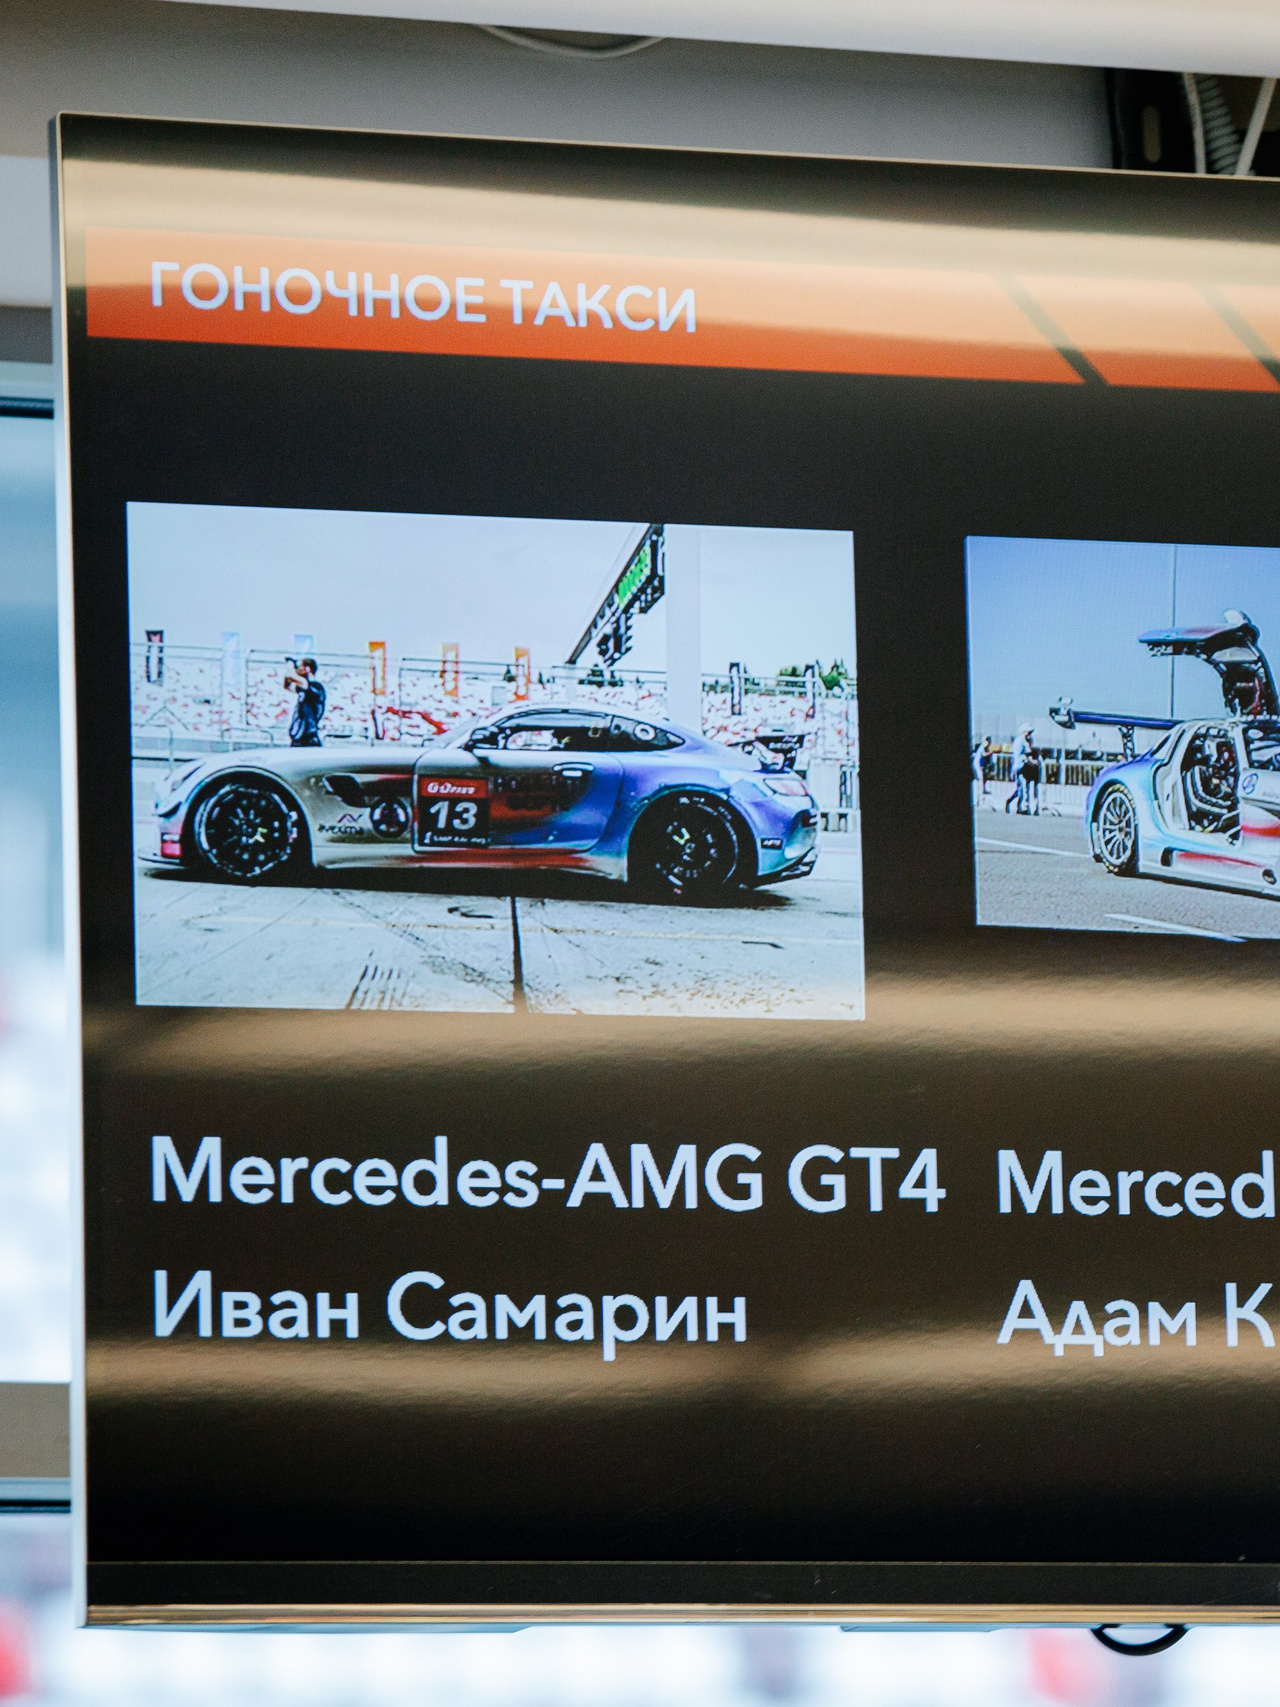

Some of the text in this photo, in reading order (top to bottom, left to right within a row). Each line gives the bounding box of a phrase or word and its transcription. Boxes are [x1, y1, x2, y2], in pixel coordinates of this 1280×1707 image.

[152, 262, 695, 332] ГОНОЧНОЕ ТАКСИ
[429, 801, 478, 830] 13
[152, 1136, 946, 1213] Mercedes-AMG GT4
[155, 1270, 746, 1361] Иван Самарин
[997, 1280, 1196, 1357] Адам
